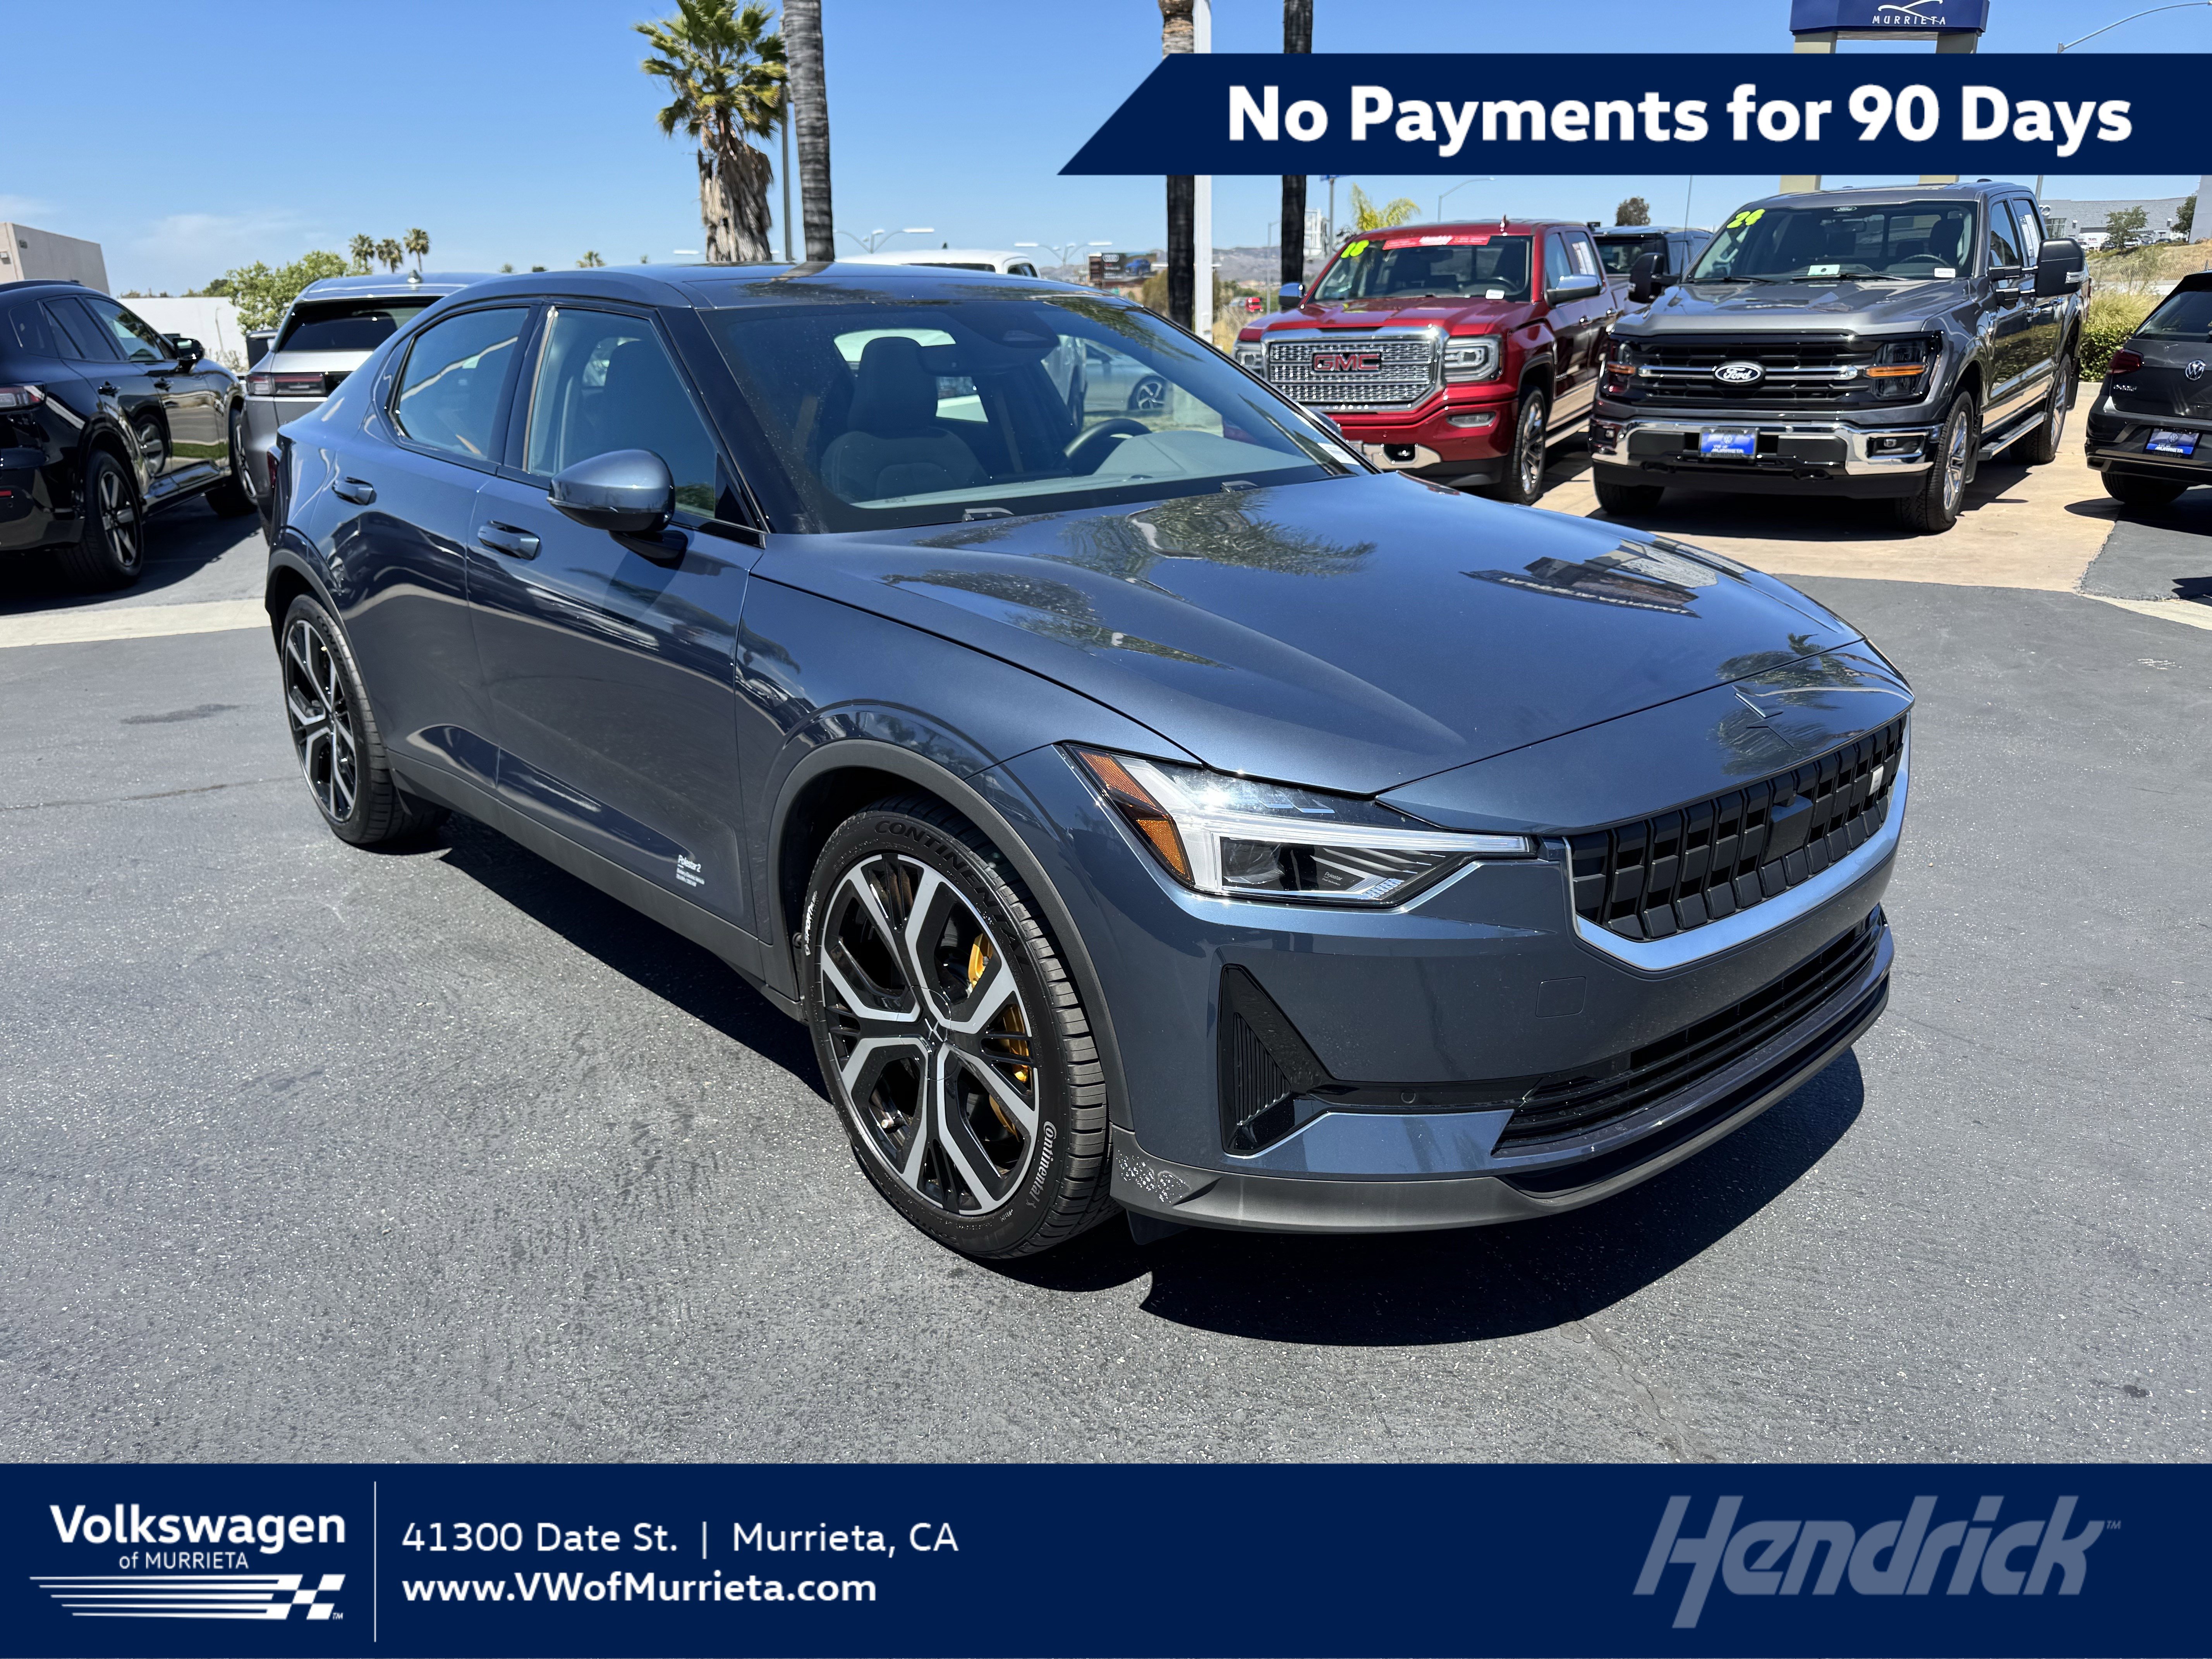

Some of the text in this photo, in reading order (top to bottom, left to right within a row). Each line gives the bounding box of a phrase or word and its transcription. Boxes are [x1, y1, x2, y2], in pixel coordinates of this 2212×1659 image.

[1872, 15, 1946, 25] MURRIETA
[1341, 240, 1369, 258] 18
[1314, 354, 1381, 371] GMC
[1723, 368, 1752, 380] Ford
[697, 864, 701, 872] 2
[874, 820, 1030, 974] CONTINENTAL
[1029, 1121, 1057, 1202] Continental
